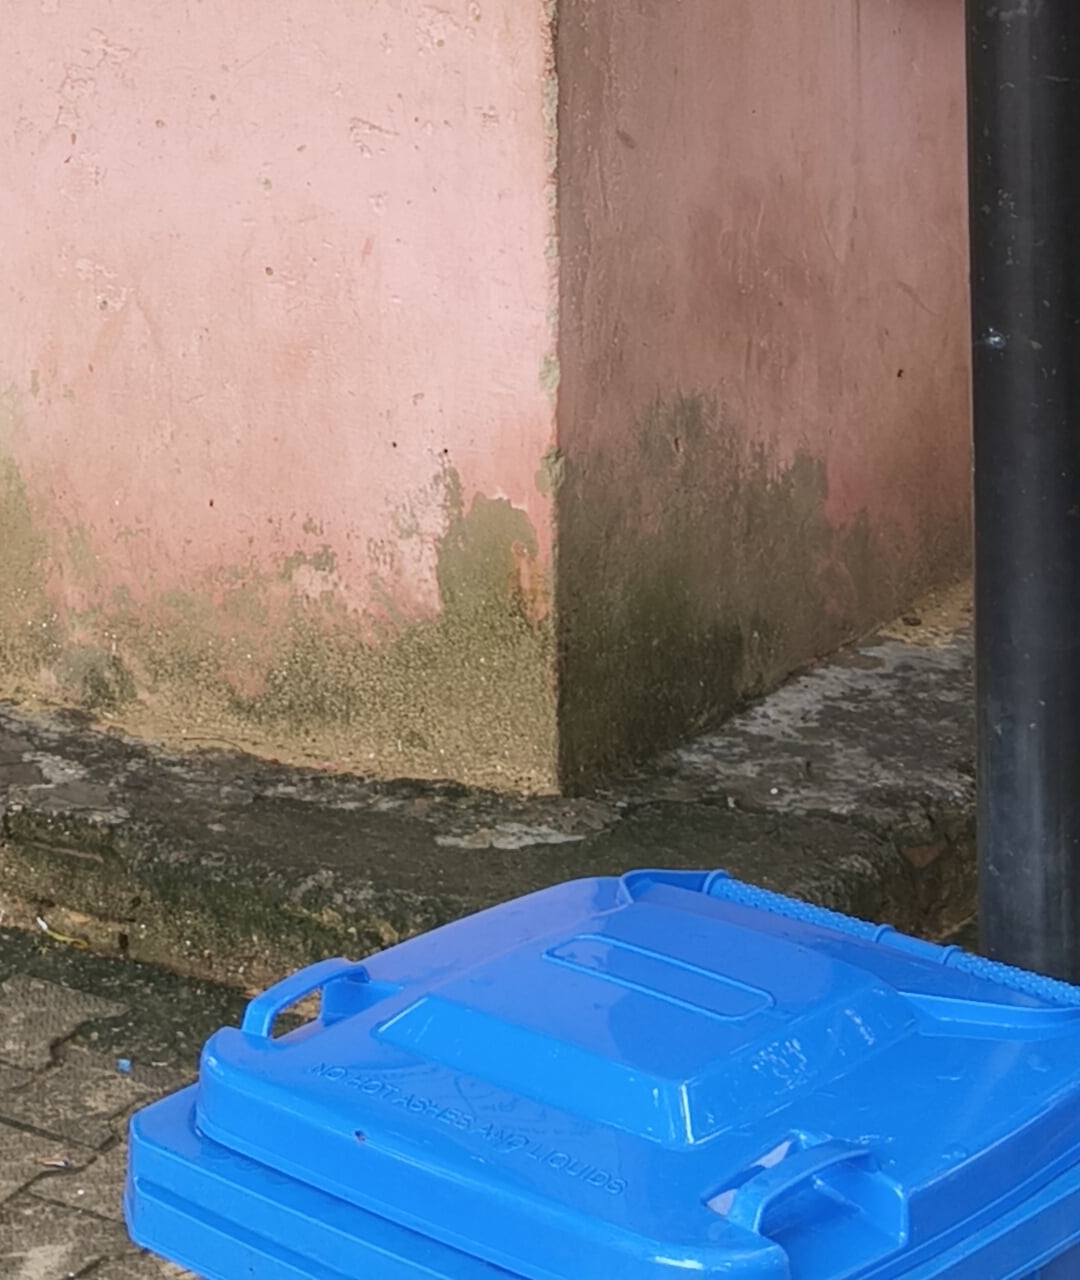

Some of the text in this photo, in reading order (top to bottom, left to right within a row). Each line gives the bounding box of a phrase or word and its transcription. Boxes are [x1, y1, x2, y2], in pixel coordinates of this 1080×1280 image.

[310, 1063, 348, 1081] NO
[351, 1074, 399, 1100] HOT
[393, 1092, 474, 1130] ASHES
[526, 1144, 630, 1196] LIQUIDS
